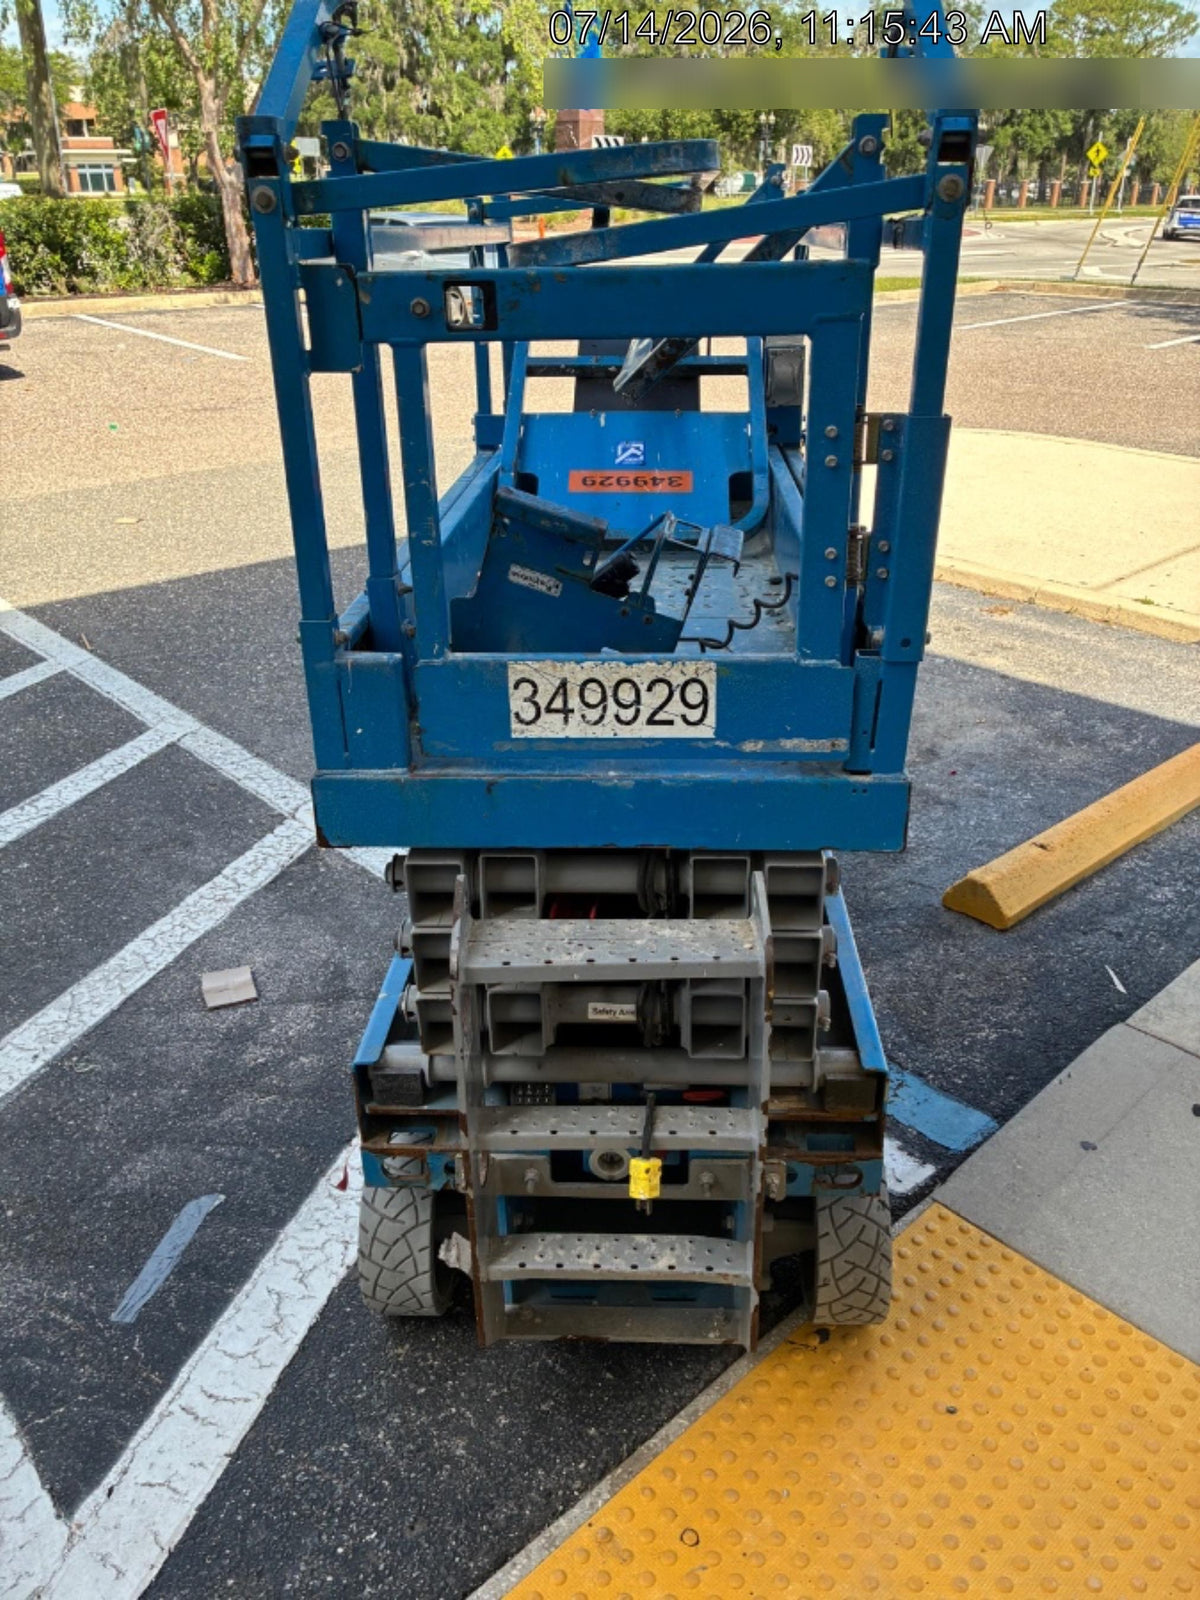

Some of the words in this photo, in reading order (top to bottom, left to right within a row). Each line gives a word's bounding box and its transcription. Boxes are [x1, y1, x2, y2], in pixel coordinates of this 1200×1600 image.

[581, 475, 683, 488] 349929
[513, 677, 709, 726] 349929
[591, 1007, 617, 1018] Safety
